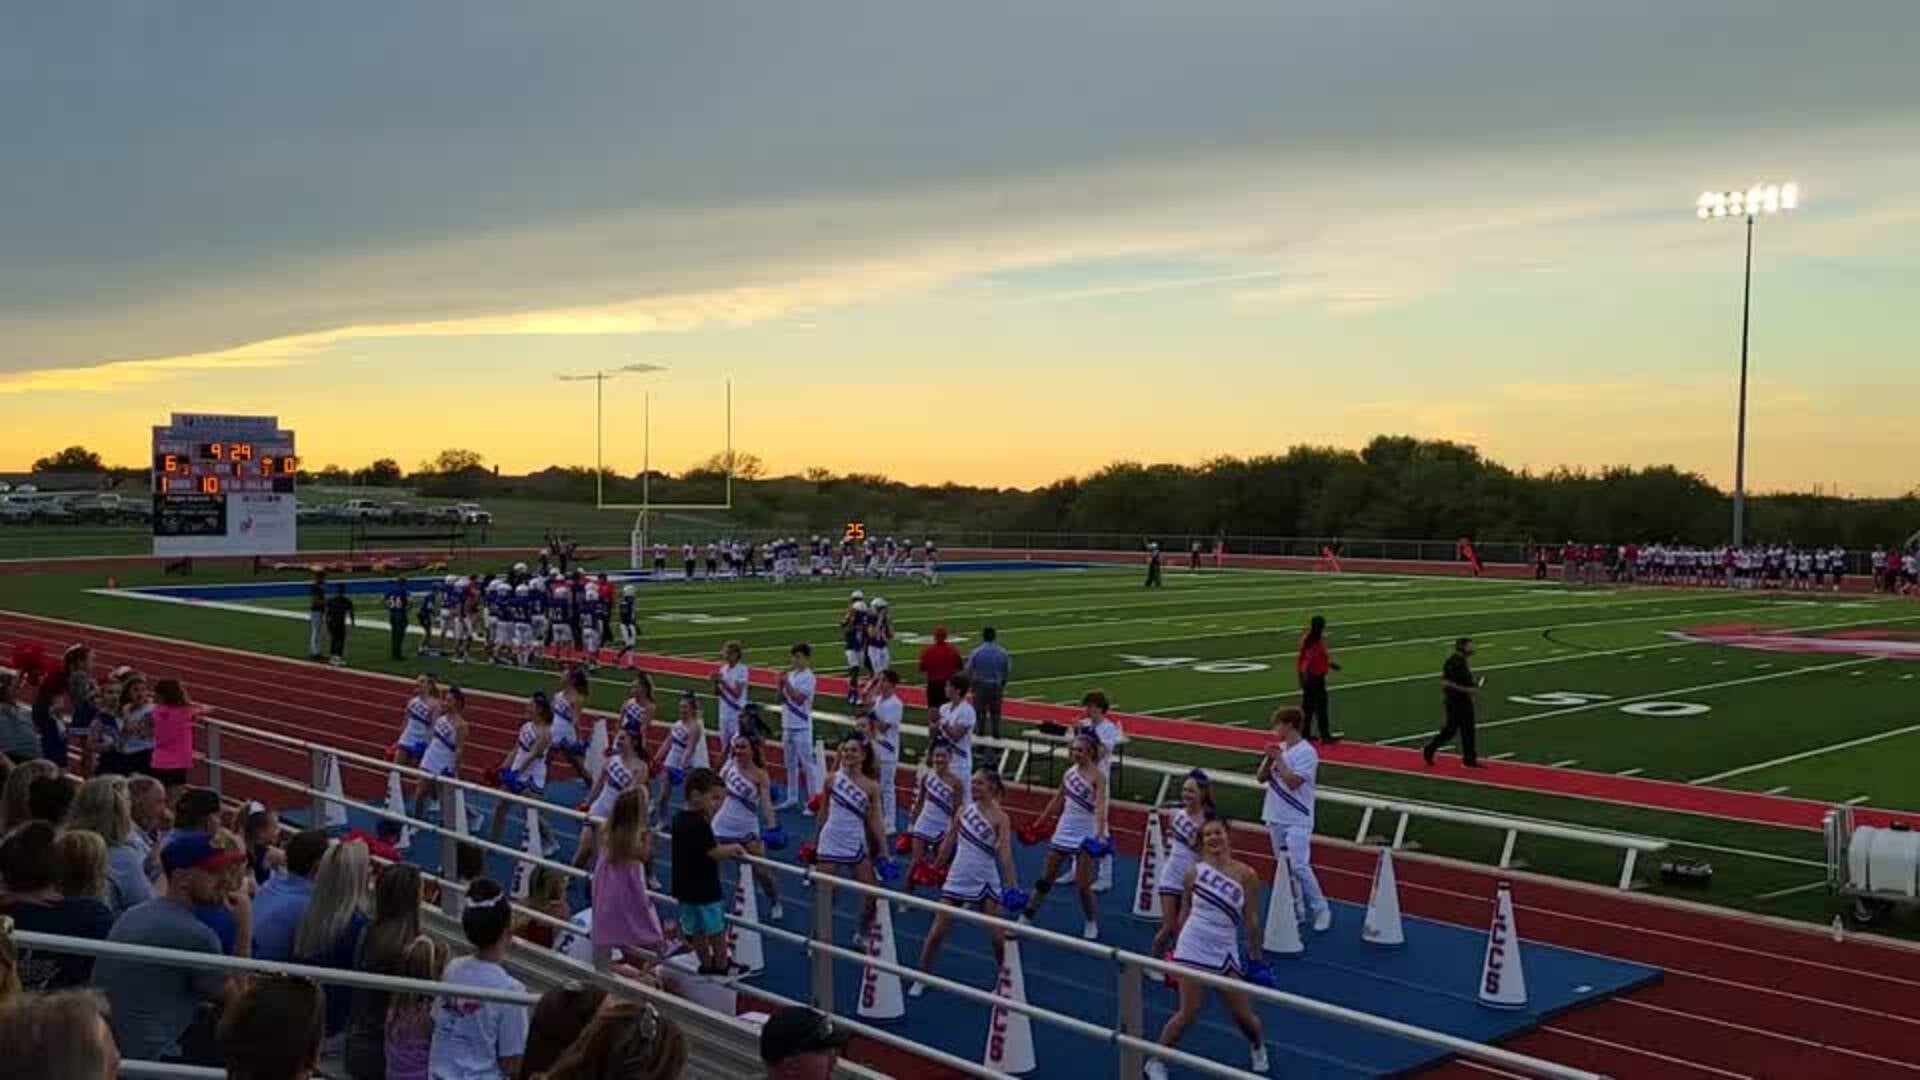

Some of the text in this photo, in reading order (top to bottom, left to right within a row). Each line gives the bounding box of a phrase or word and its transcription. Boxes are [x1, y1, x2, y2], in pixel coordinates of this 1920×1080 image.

[210, 443, 222, 460] 9
[230, 443, 252, 460] 29
[164, 454, 177, 472] 6
[283, 456, 296, 473] 0
[202, 476, 219, 494] 10
[845, 522, 866, 539] 25
[1506, 691, 1712, 716] 50
[1139, 830, 1156, 911] LCCS
[1200, 870, 1242, 902] LCCS
[1486, 891, 1507, 994] LCCS
